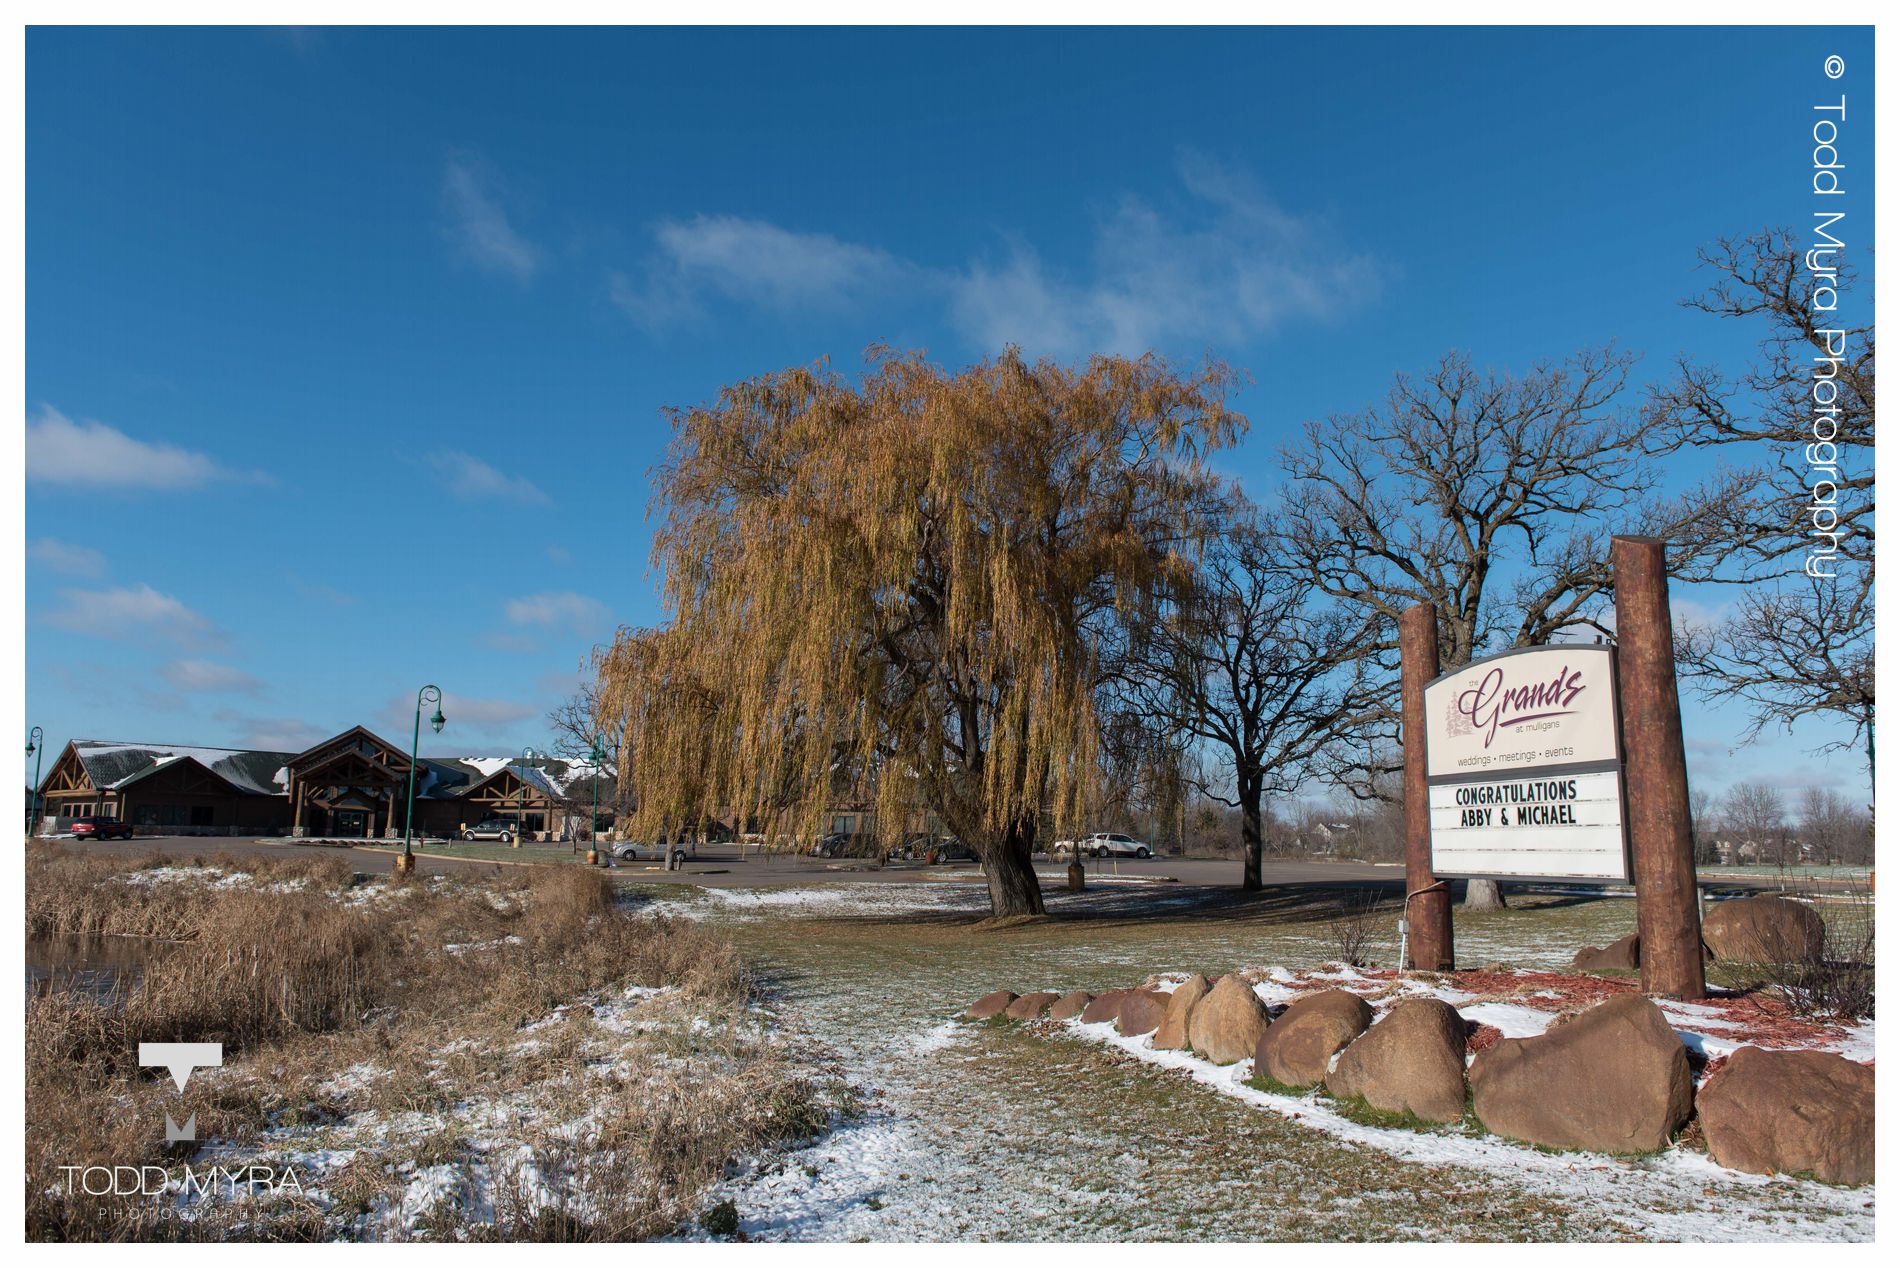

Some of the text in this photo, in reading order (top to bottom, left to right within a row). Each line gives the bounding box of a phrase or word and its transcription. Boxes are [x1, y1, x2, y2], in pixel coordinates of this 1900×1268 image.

[1458, 665, 1586, 749] Grands
[1515, 720, 1560, 734] at mulligans
[1457, 746, 1574, 767] weddings meetings events
[1456, 780, 1577, 806] CONGRATULATIONS
[1461, 804, 1577, 827] ABBY & MICHAEL
